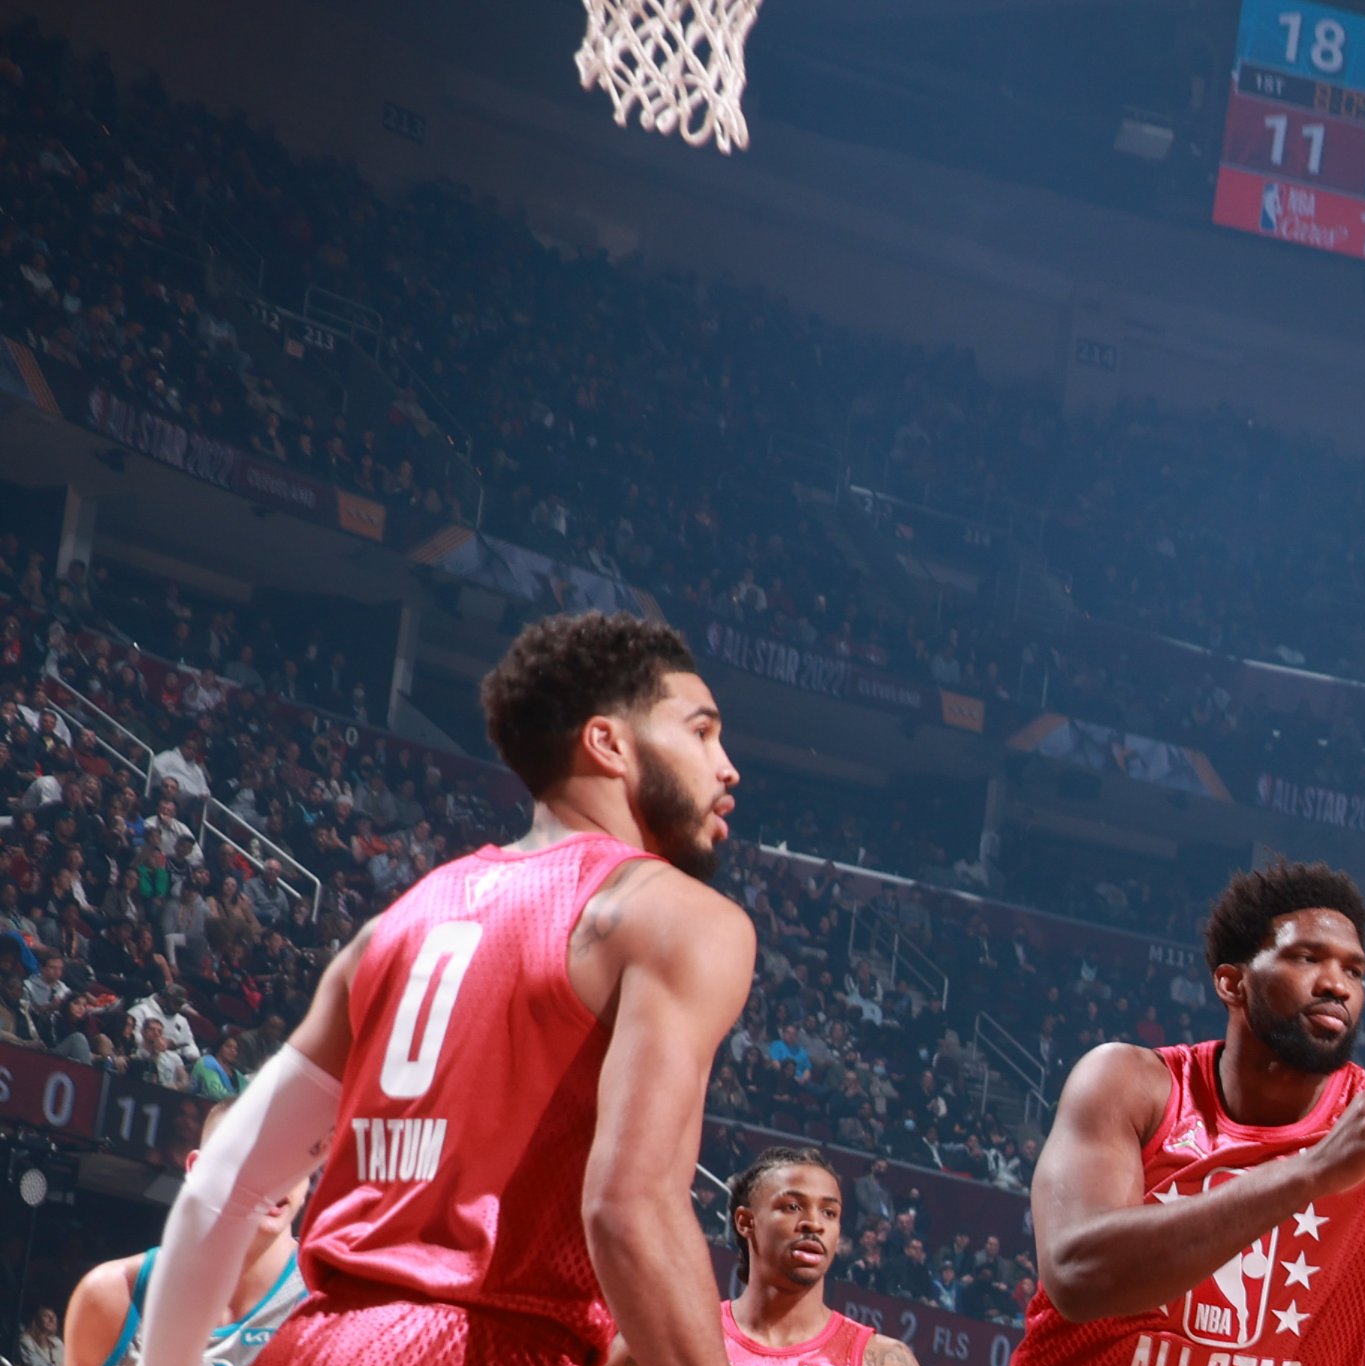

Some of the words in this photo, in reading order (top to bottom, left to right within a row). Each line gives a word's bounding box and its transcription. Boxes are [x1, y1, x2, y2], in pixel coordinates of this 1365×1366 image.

[1278, 12, 1345, 73] 18
[1255, 73, 1285, 95] 1ST
[1264, 114, 1325, 176] 11
[304, 325, 335, 350] 213
[380, 920, 484, 1100] 0
[41, 1070, 76, 1128] 0
[116, 1096, 162, 1147] 11
[351, 1118, 447, 1183] TATUM
[844, 1302, 884, 1334] PTS
[899, 1307, 918, 1339] 2
[932, 1325, 970, 1361] FLS
[1194, 1302, 1231, 1336] NBA
